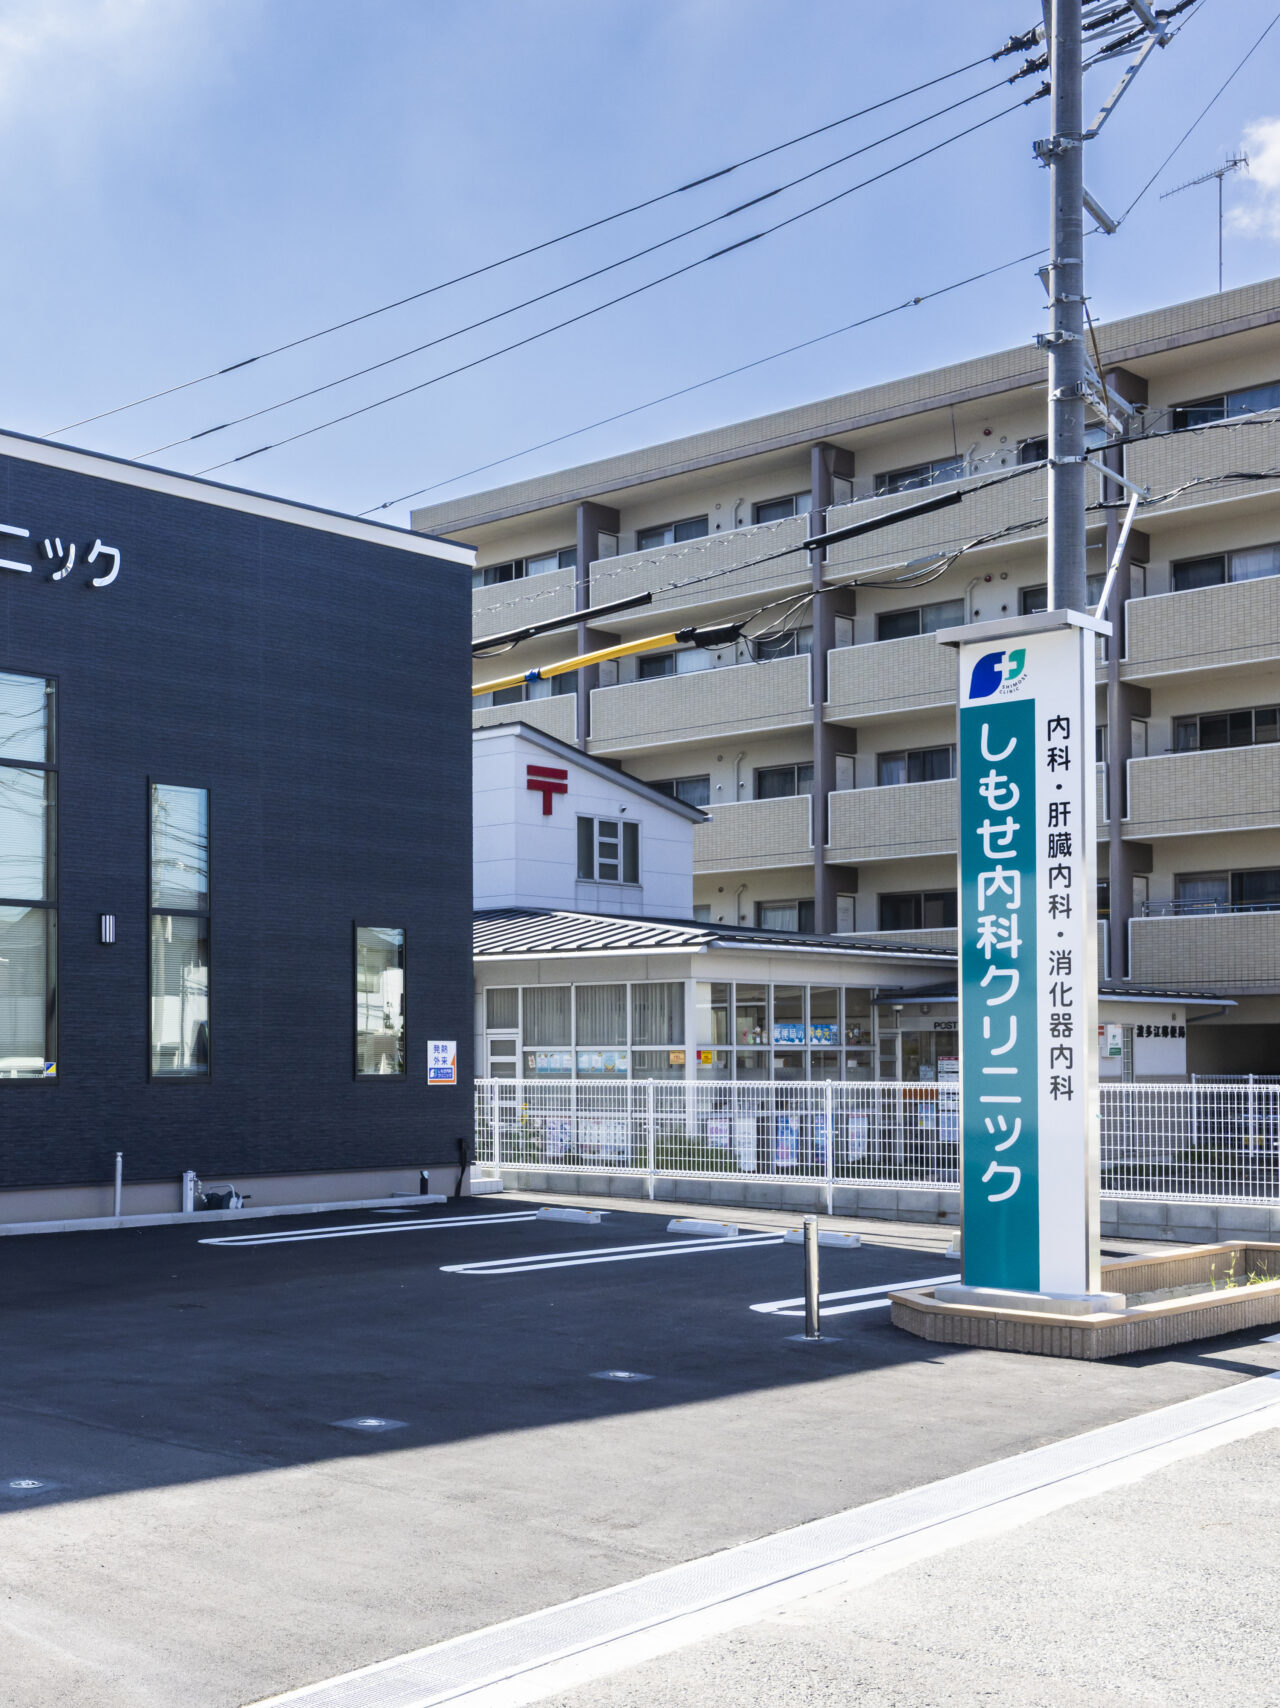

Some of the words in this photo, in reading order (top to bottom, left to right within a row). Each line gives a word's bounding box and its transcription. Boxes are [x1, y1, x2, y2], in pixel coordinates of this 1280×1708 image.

[1001, 673, 1028, 690] SHIMOSE
[999, 686, 1020, 695] CLINIC
[976, 722, 1023, 1203] しもせ内科クリニック
[933, 1021, 958, 1030] POST
[433, 1056, 448, 1066] 外来
